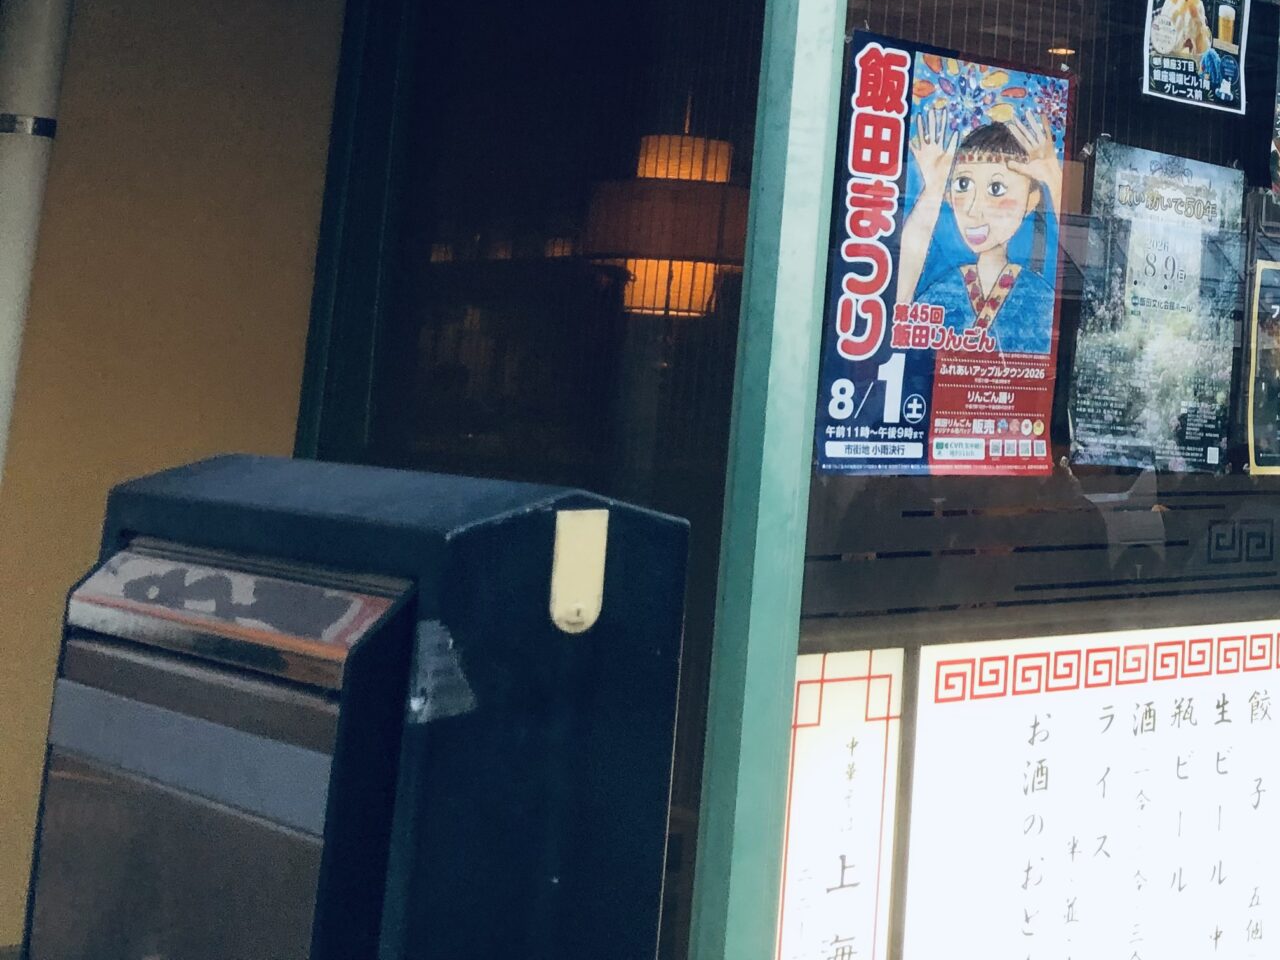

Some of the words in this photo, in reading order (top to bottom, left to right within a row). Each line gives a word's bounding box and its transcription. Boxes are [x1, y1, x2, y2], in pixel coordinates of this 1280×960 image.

[837, 42, 911, 361] 飯田まつり
[891, 323, 996, 353] 飯田りんごん
[893, 304, 945, 324] 第45回
[940, 364, 1045, 379] ふれあいアップルタウン2026
[828, 352, 906, 424] 8/1
[1133, 700, 1158, 737] 酒
[1247, 688, 1274, 811] 餃子
[1020, 712, 1053, 960] お酒のおと
[1094, 704, 1116, 860] ライス
[1169, 696, 1199, 894] 瓶ビール
[1210, 691, 1232, 886] 生ビール
